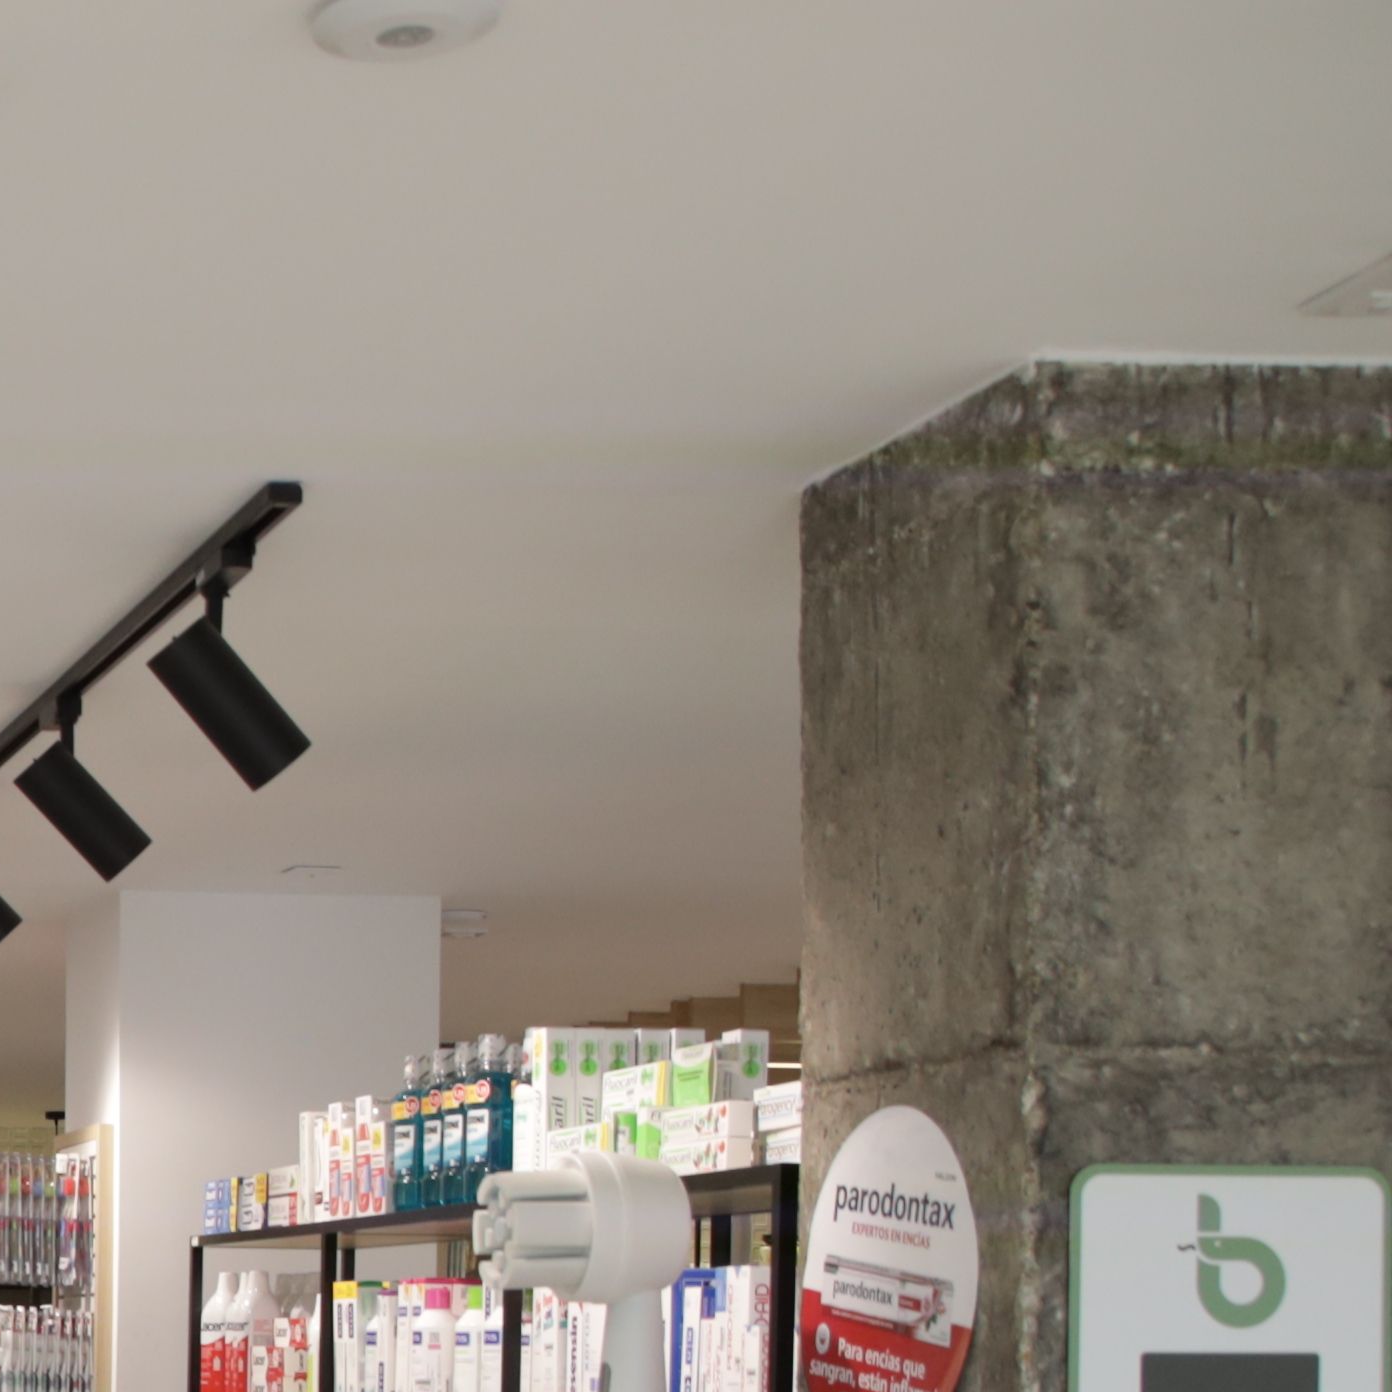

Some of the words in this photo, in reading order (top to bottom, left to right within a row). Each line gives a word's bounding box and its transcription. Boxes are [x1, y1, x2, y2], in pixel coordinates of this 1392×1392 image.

[833, 1182, 956, 1230] parodontax
[852, 1222, 889, 1239] EXPERTOS
[891, 1229, 901, 1242] EN
[833, 1279, 893, 1306] parodontax
[809, 1358, 856, 1388] sangran,
[838, 1337, 863, 1362] Para
[902, 1359, 926, 1381] que
